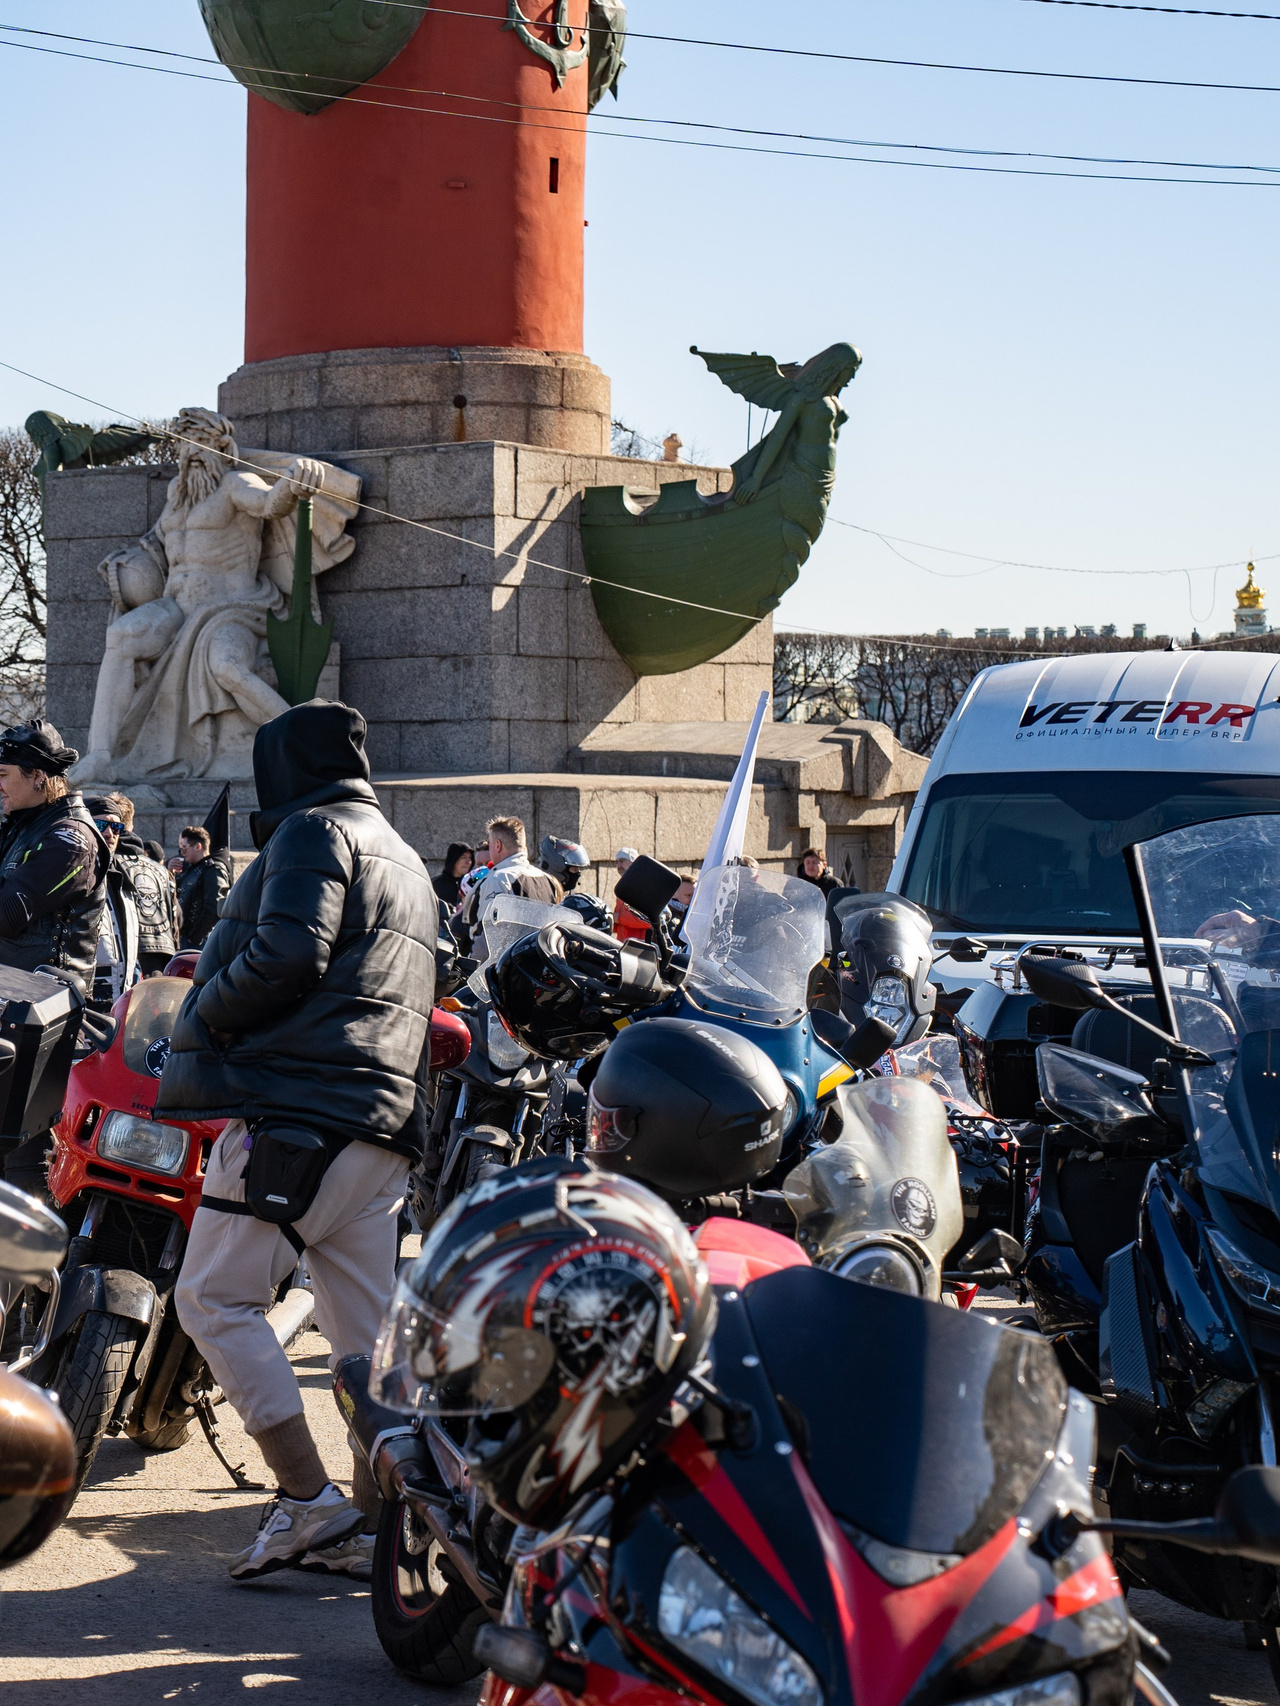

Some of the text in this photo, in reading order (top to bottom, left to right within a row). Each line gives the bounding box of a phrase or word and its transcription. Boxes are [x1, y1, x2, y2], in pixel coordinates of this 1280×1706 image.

[1019, 700, 1256, 728] VETERR
[1015, 725, 1242, 740] ОФИЦИАЛЬНЫЙ ДИЛЕР BRP
[696, 1030, 739, 1059] SHARK
[743, 1128, 780, 1152] SHARK
